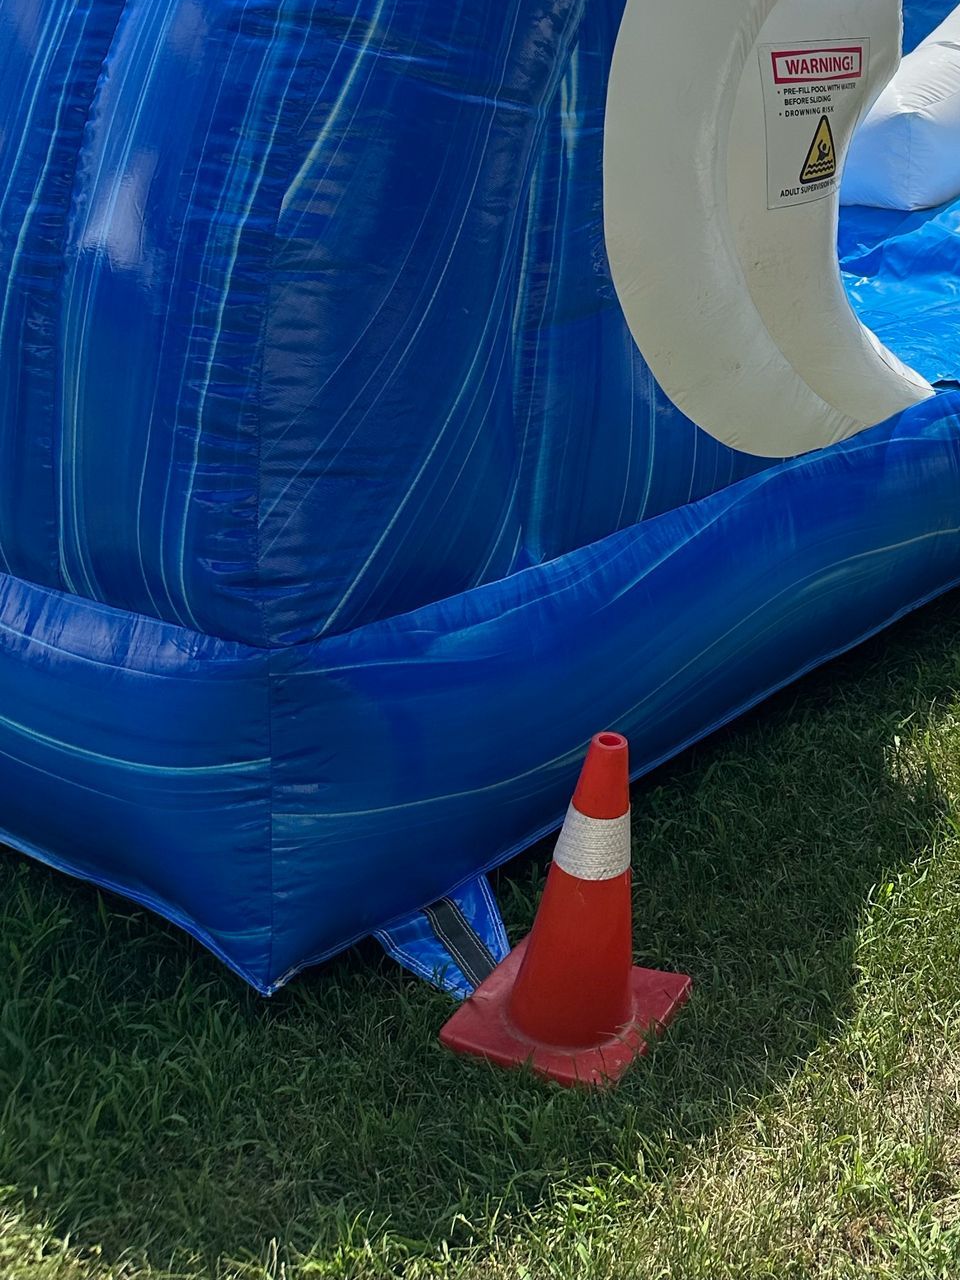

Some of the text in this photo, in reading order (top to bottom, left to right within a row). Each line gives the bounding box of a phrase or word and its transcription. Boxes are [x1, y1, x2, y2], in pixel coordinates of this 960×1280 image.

[785, 56, 854, 75] WARNING!
[783, 86, 810, 95] PRE-FILL
[811, 85, 826, 93] POOL
[784, 95, 831, 106] BEFORE SLIDING
[785, 107, 820, 117] DROWNING
[780, 187, 800, 197] ADULT
